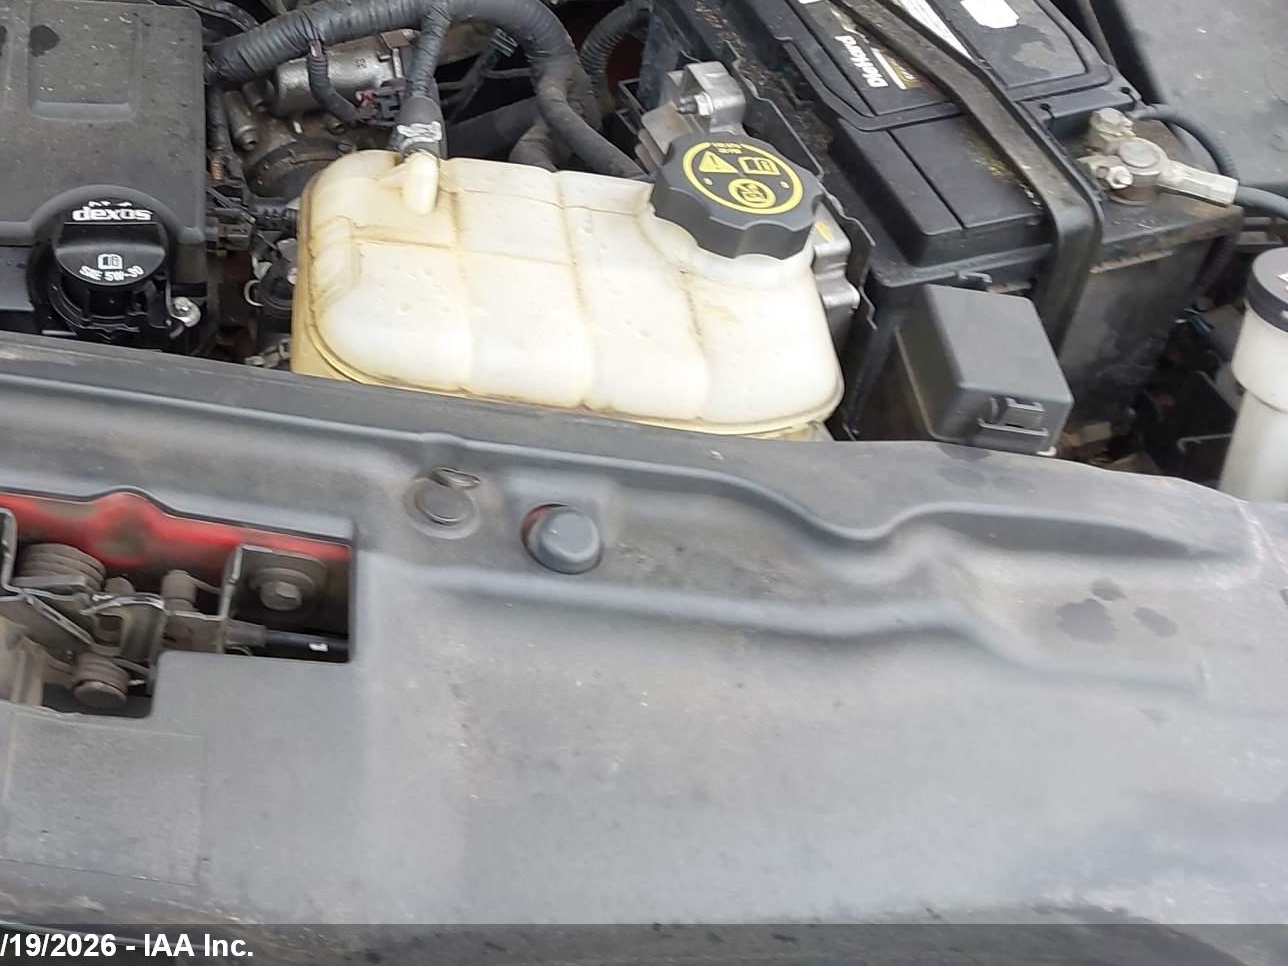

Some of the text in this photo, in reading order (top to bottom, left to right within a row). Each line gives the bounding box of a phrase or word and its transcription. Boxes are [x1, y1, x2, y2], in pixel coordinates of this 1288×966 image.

[834, 35, 889, 88] DieHard
[72, 206, 153, 221] dexos
[79, 265, 144, 281] SAE 5W-30
